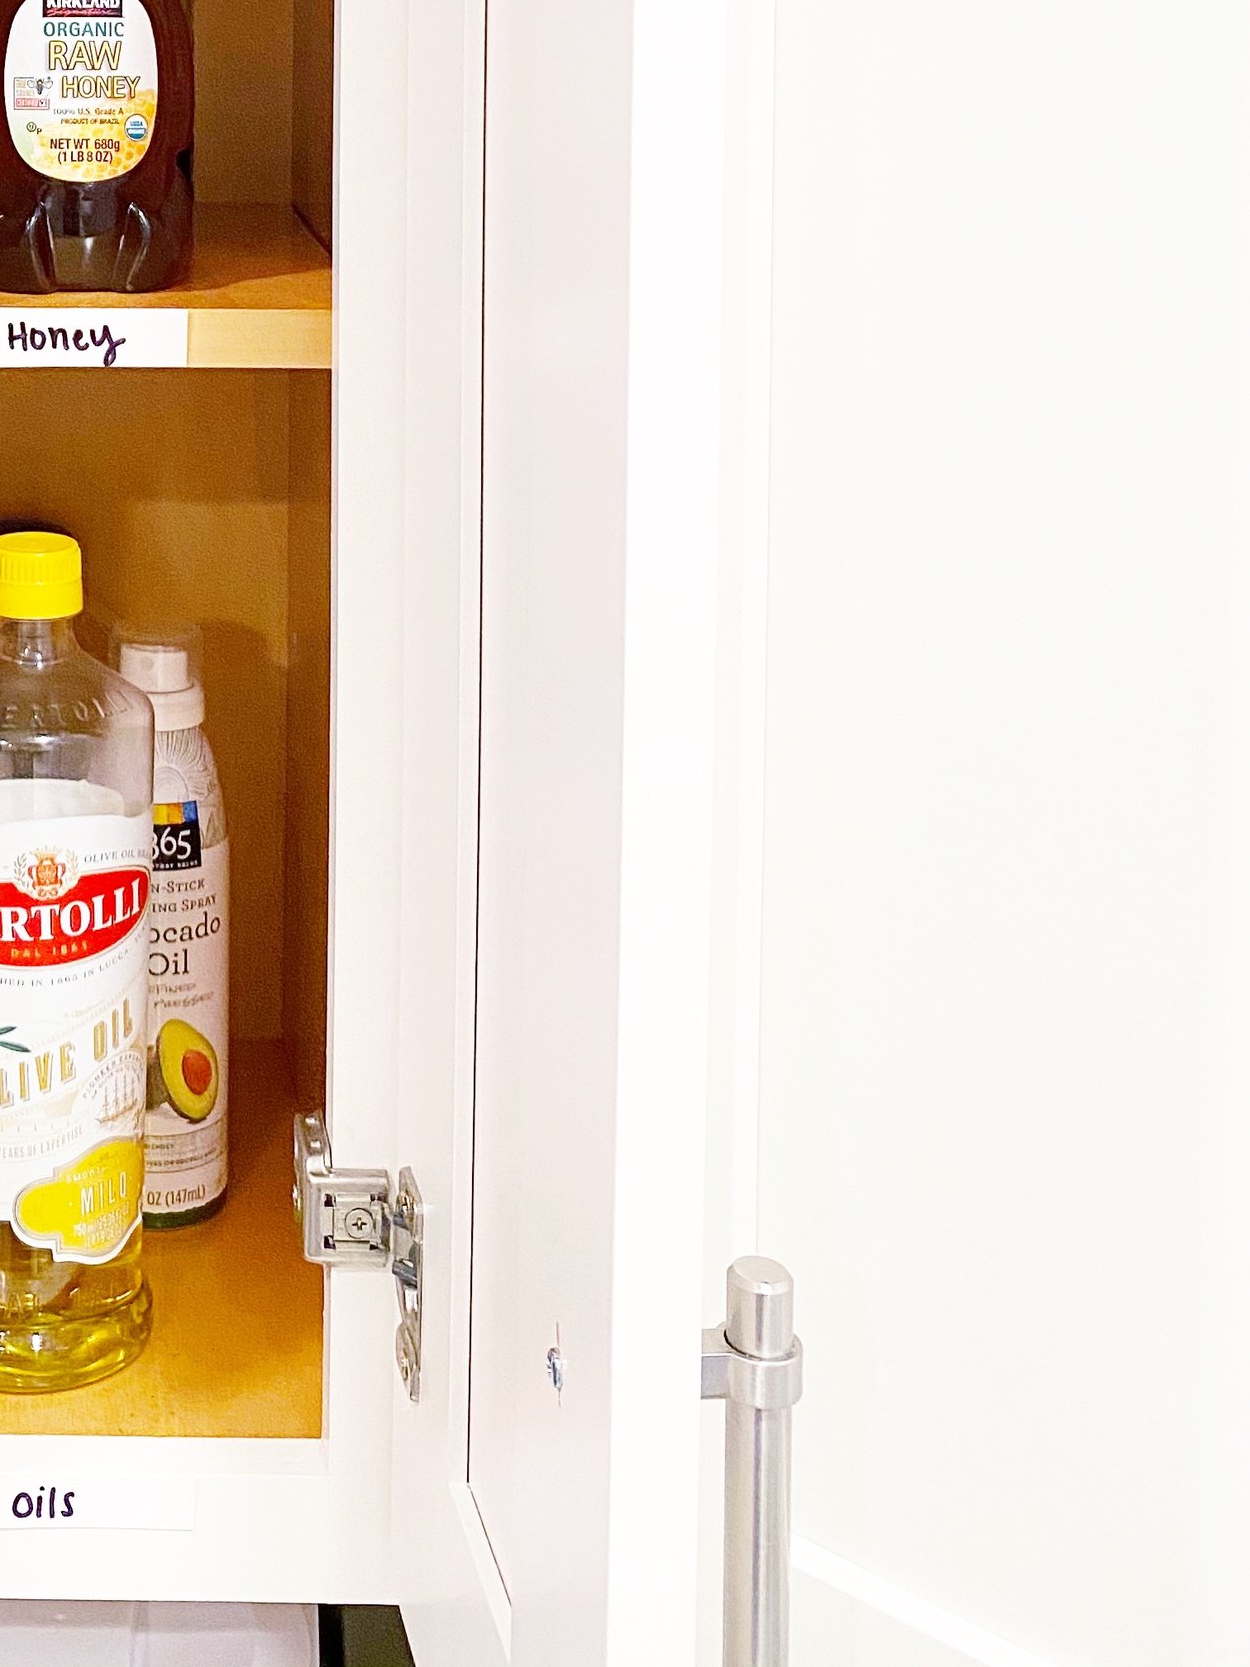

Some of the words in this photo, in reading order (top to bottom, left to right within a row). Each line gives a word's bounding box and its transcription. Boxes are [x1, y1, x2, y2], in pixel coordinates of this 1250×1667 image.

[43, 21, 125, 37] ORGANIC
[48, 40, 123, 71] RAW
[61, 75, 141, 99] HONEY
[50, 138, 71, 150] NET
[73, 138, 90, 150] WT
[94, 138, 120, 152] 680g
[58, 151, 67, 164] (1
[70, 151, 84, 162] LB
[86, 151, 93, 162] 8
[95, 151, 113, 164] OZ)
[8, 321, 126, 367] Honey
[148, 948, 190, 977] Oil
[94, 997, 133, 1063] OIL
[147, 1191, 161, 1205] OZ
